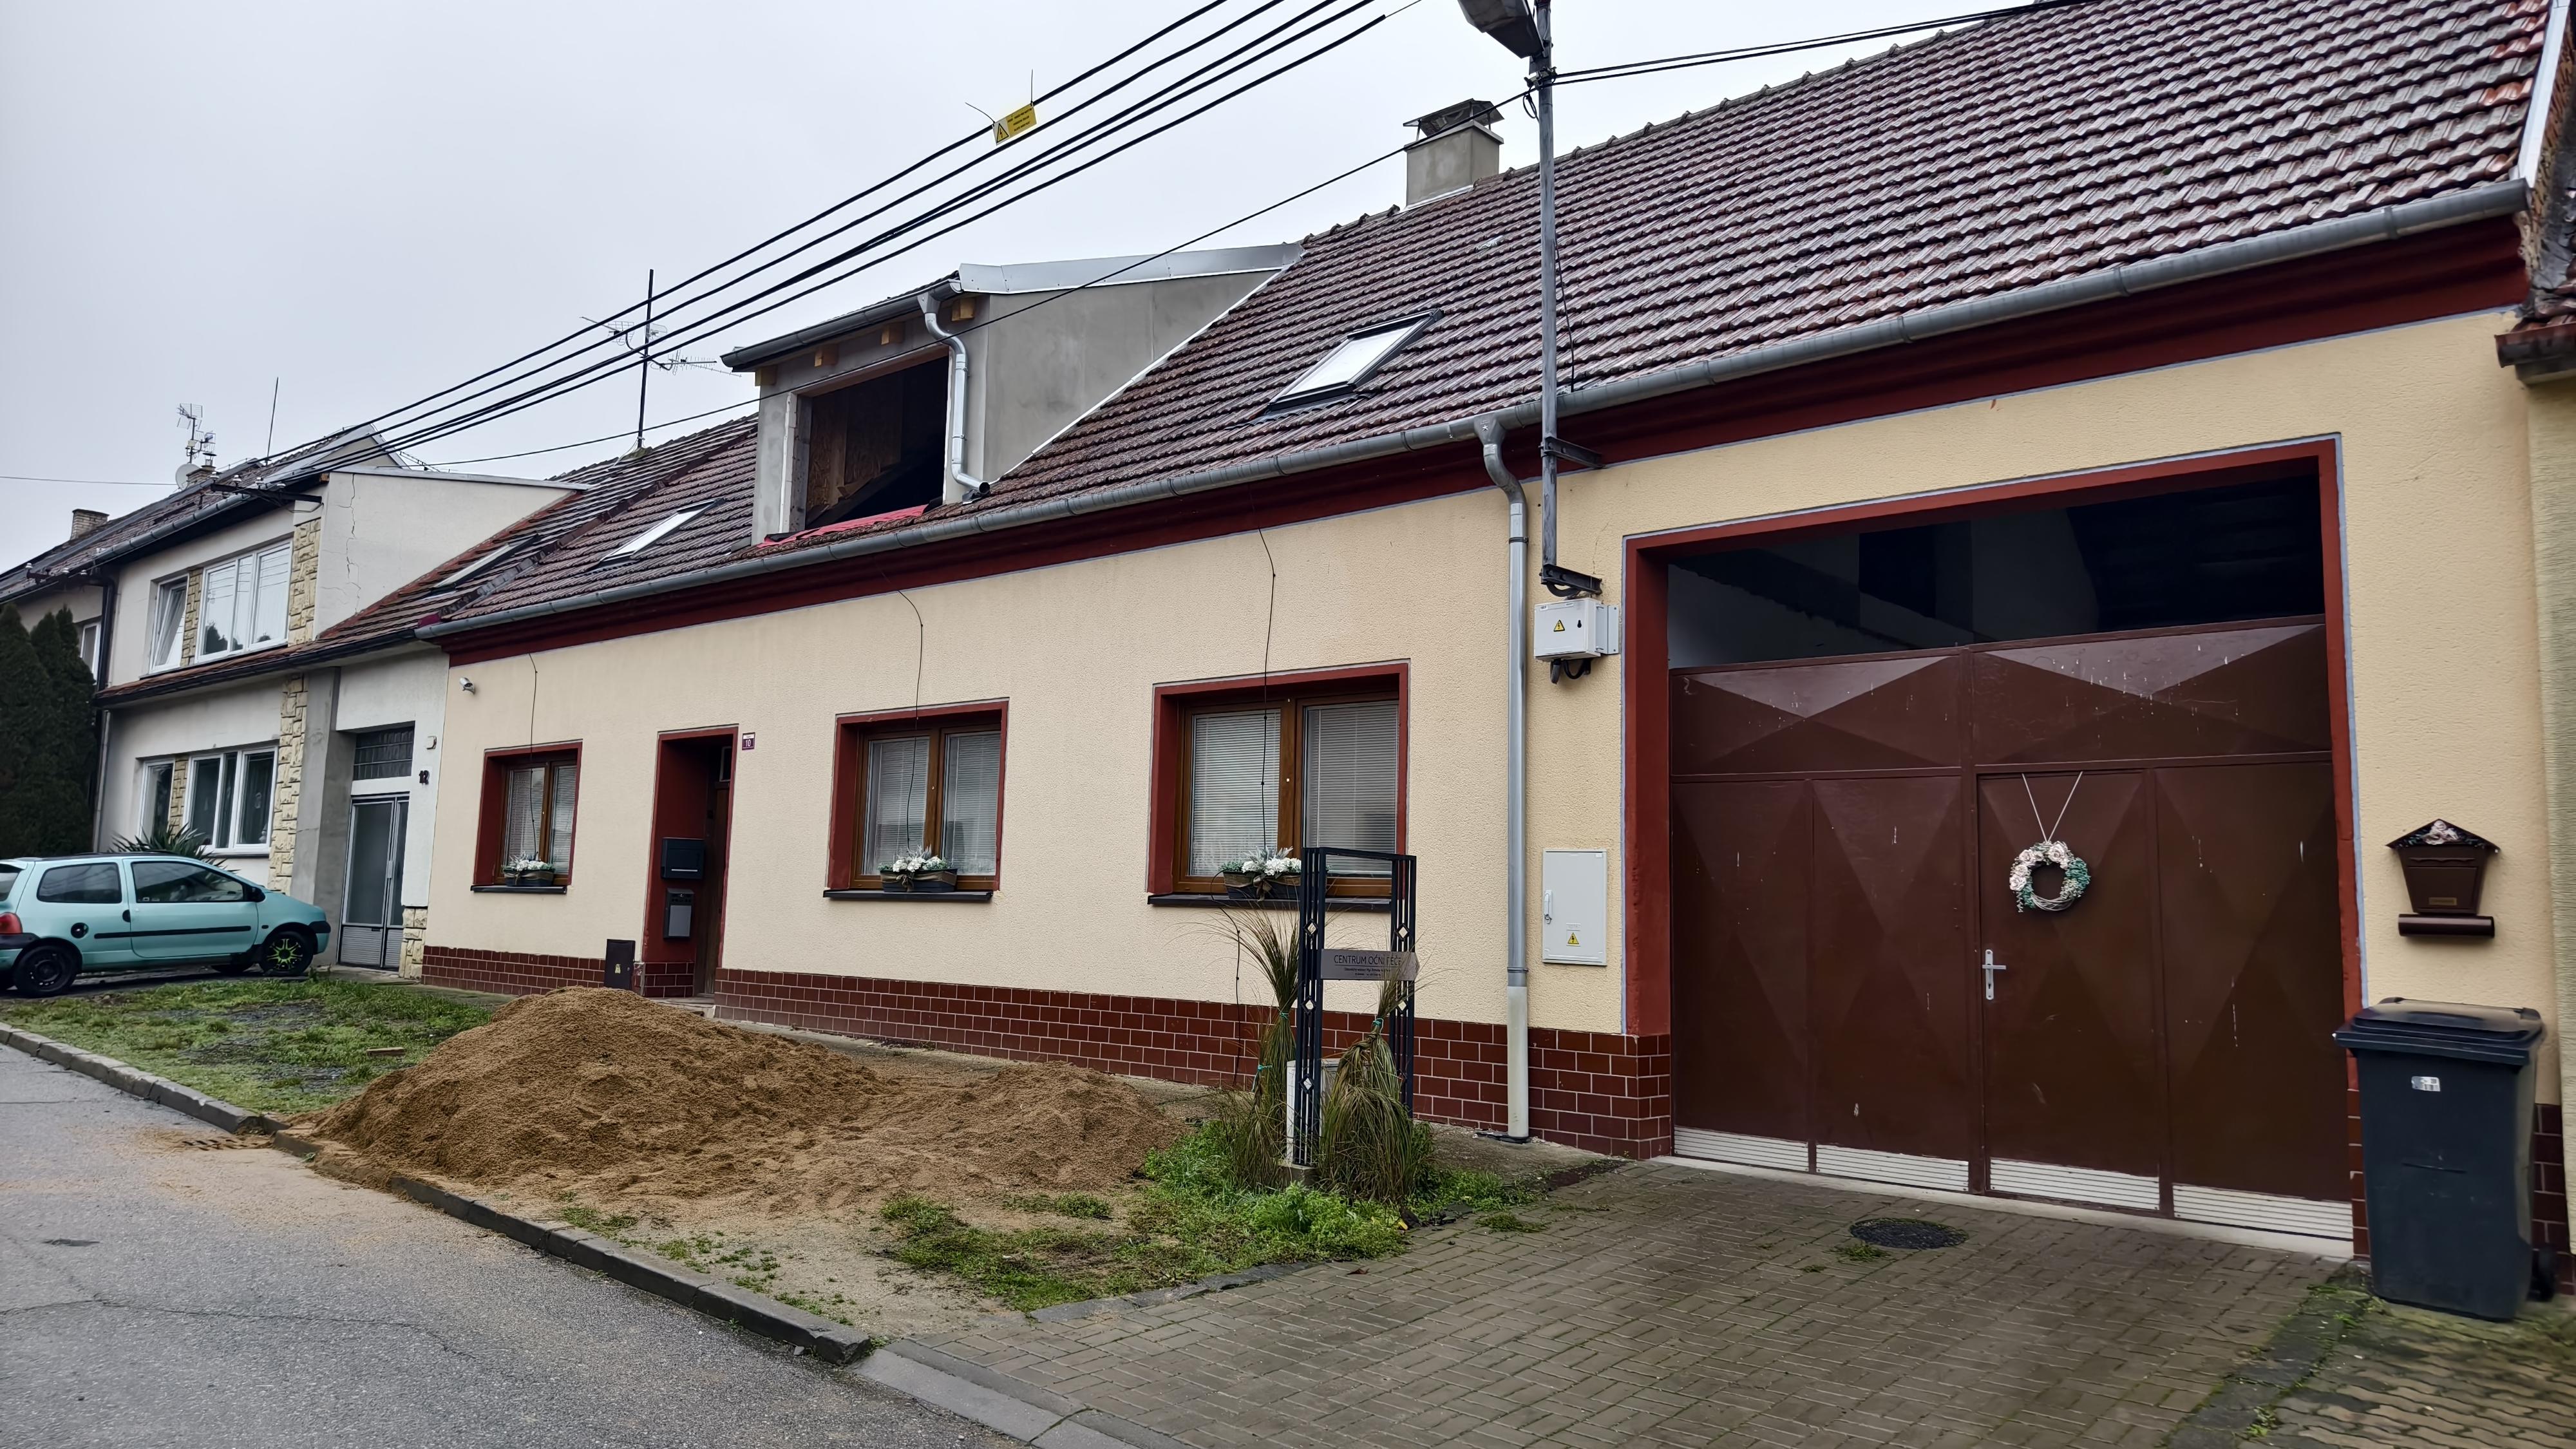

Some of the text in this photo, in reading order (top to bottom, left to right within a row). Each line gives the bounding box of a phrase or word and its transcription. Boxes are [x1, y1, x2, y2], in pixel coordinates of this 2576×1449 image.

[746, 739, 751, 747] 10
[419, 770, 430, 785] 12
[1334, 954, 1366, 964] CENTRUM
